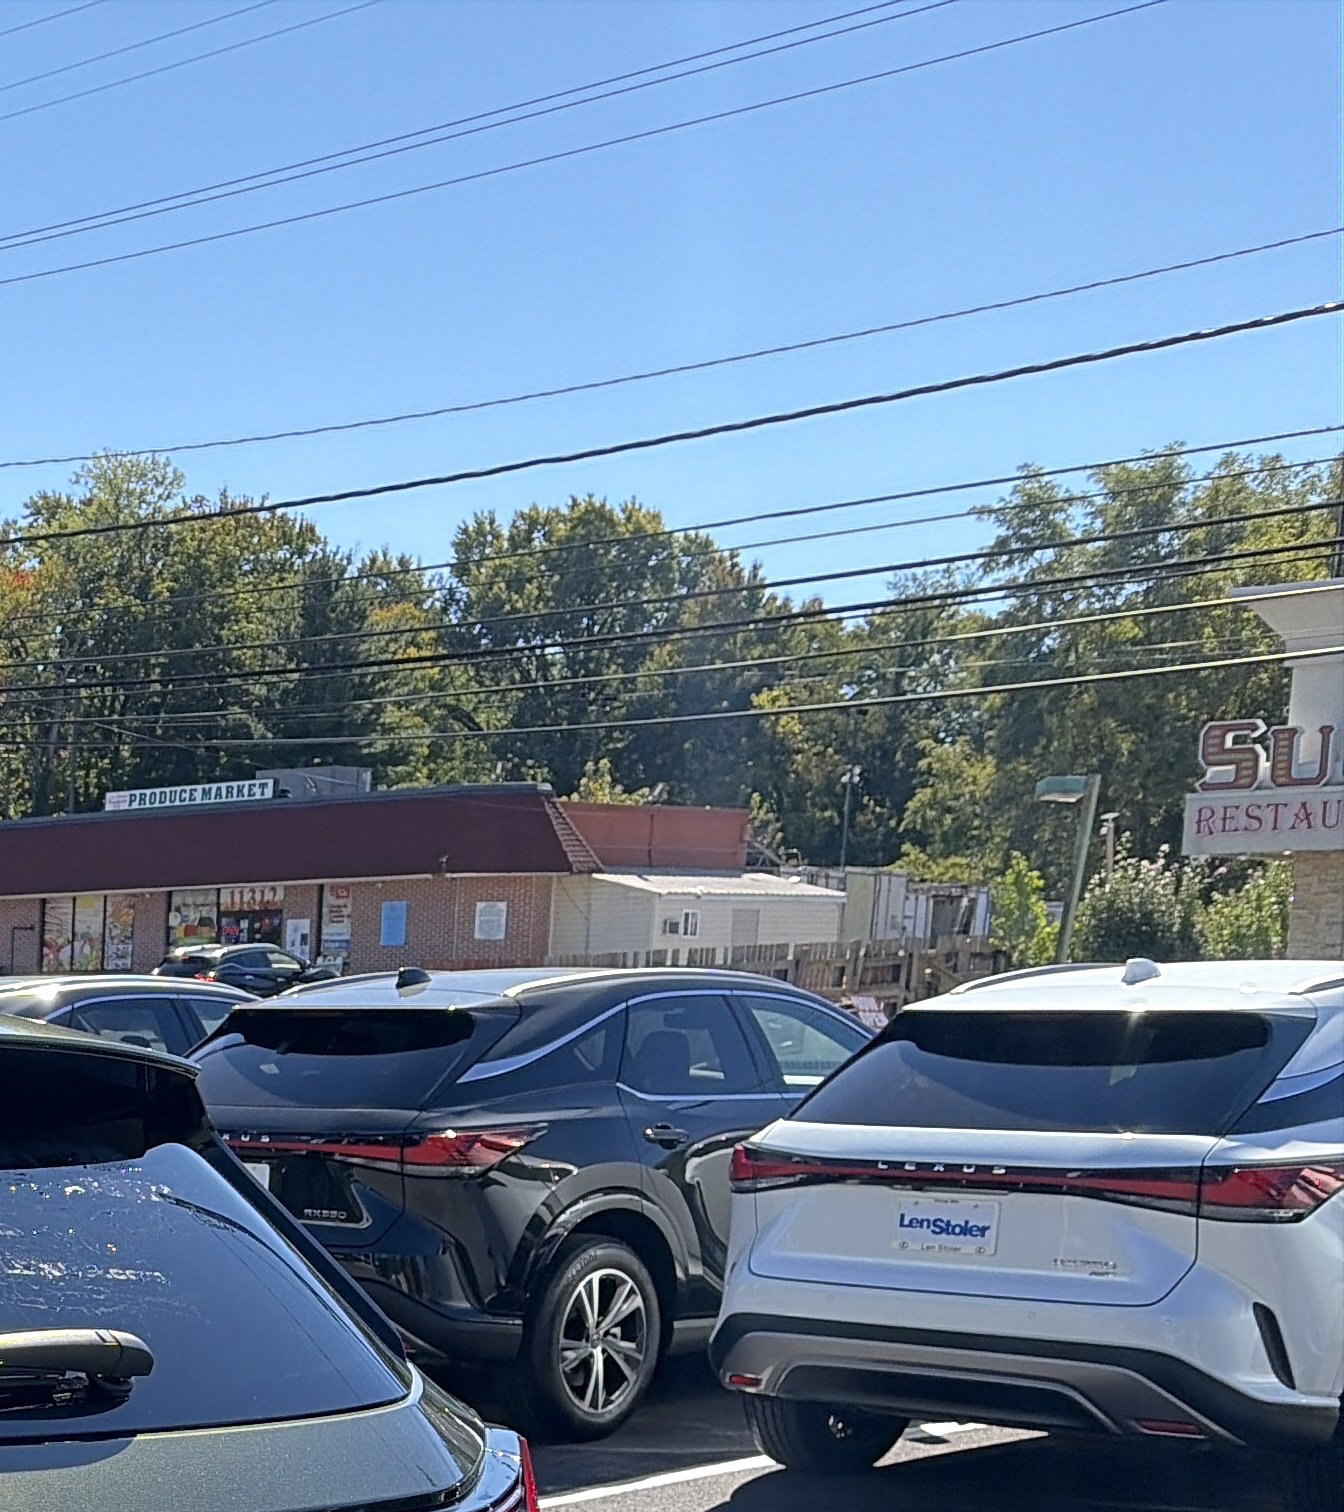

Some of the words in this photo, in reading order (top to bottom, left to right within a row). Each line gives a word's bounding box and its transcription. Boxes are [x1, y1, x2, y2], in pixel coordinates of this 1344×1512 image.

[128, 788, 197, 807] PRODUCE
[200, 782, 269, 801] MARKET
[877, 1160, 1007, 1175] LEXUS
